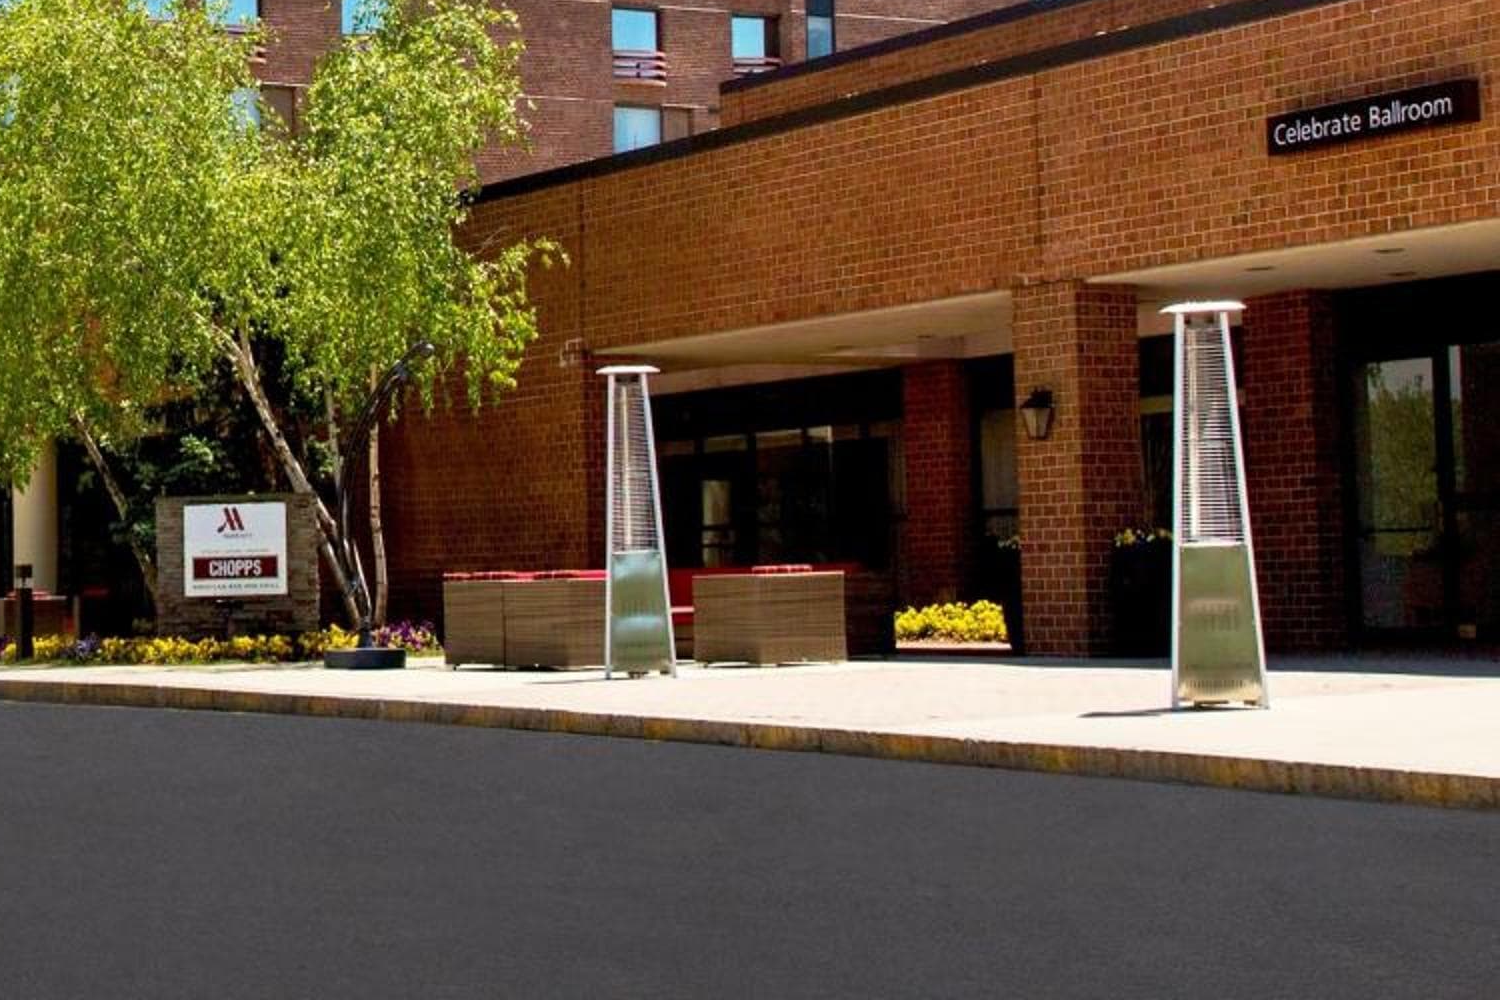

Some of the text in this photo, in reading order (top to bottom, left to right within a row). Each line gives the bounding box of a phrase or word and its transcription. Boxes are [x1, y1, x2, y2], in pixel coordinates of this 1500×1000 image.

[1273, 96, 1453, 146] Celebrate Ballroom
[209, 559, 262, 577] CHOPPS
